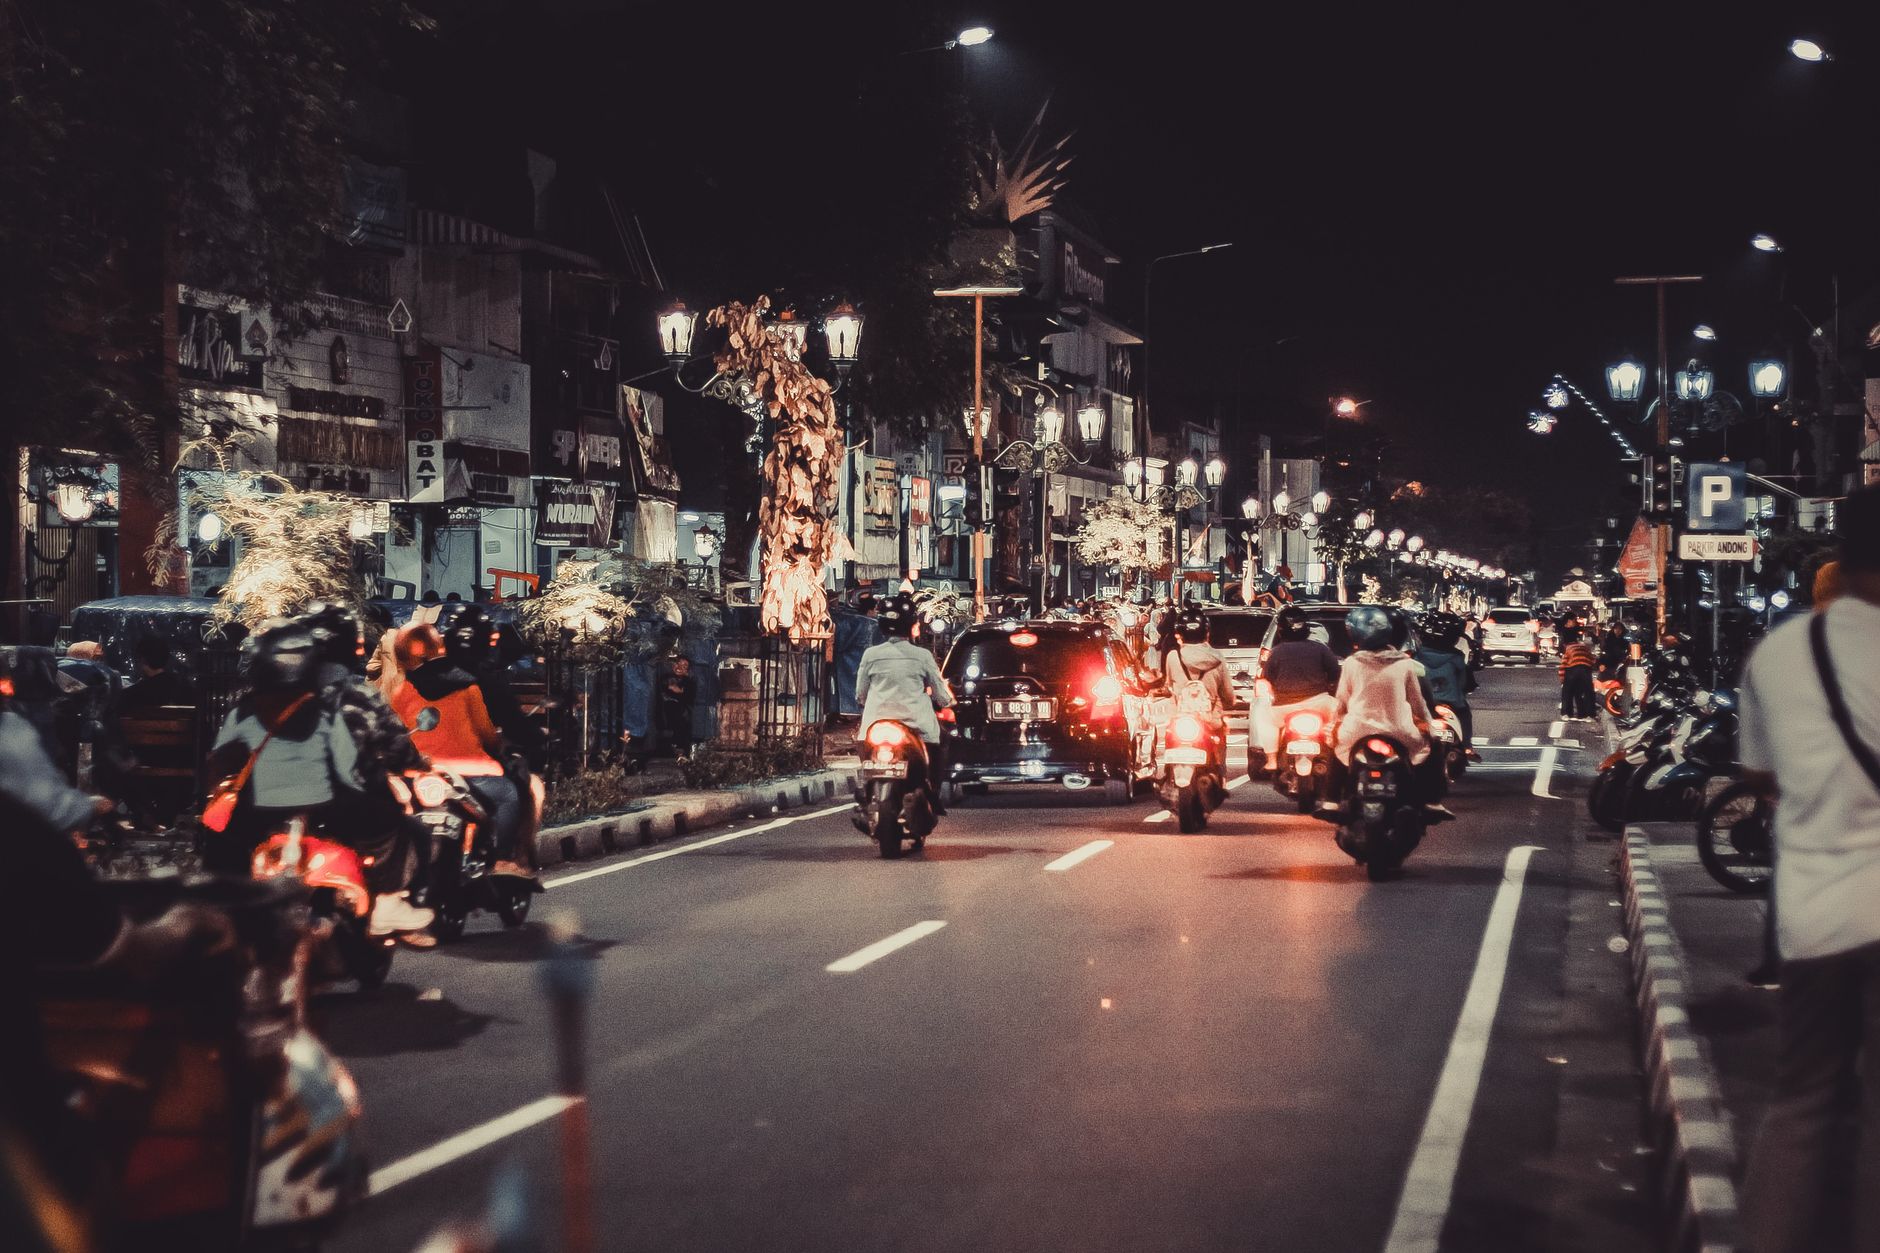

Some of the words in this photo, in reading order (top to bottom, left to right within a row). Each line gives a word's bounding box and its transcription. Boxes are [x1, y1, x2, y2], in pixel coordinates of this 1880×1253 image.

[413, 361, 436, 423] TOKO
[416, 428, 436, 489] OBAT
[1702, 475, 1732, 517] P
[1687, 541, 1714, 553] PARKIR
[1717, 541, 1748, 553] ANDONG
